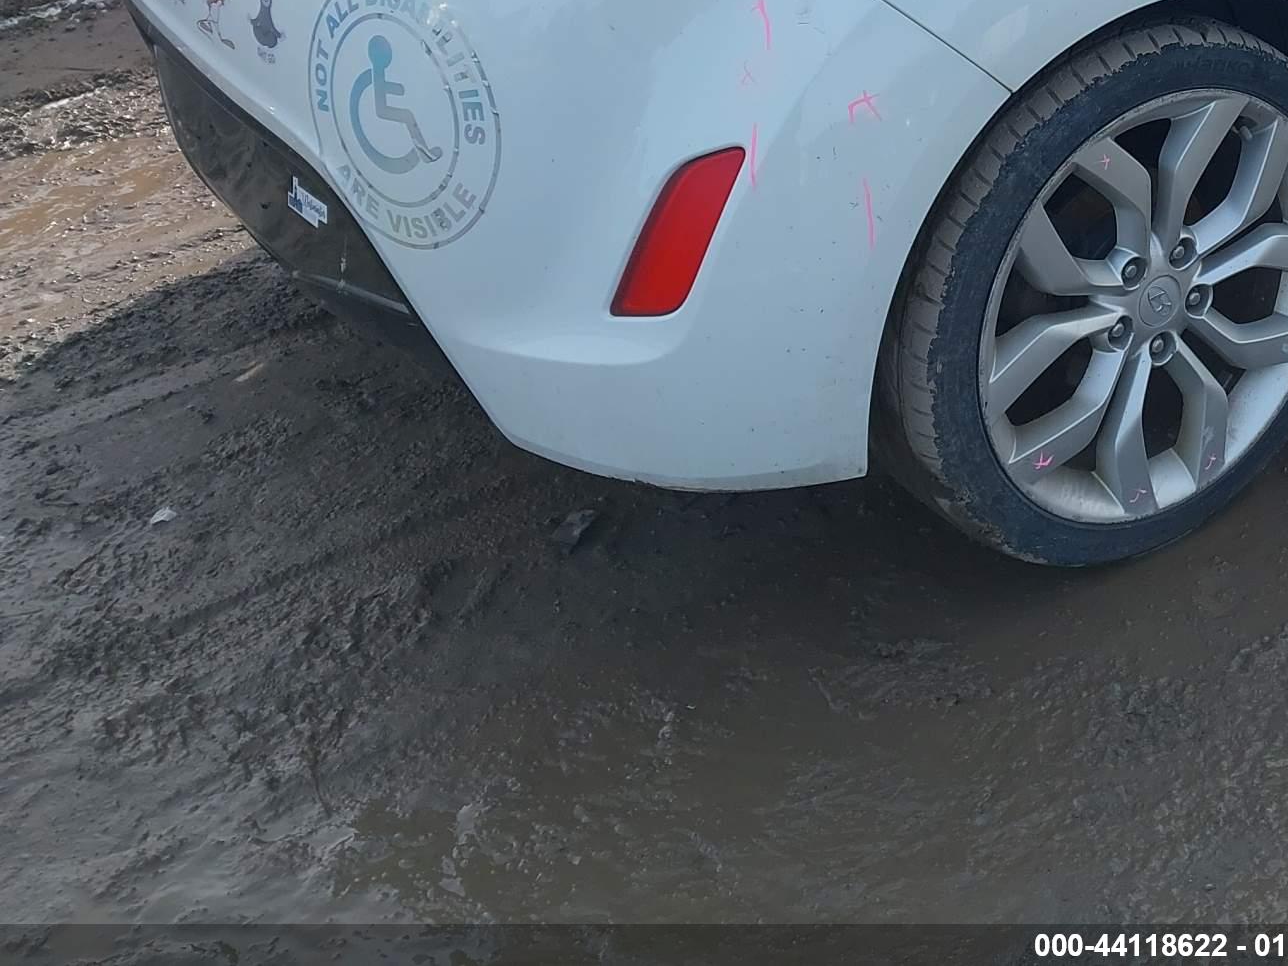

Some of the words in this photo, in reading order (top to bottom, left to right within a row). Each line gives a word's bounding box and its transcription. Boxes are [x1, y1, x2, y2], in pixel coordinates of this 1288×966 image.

[315, 38, 330, 113] NOT
[337, 164, 381, 220] ARE
[386, 182, 478, 240] VISIBLE
